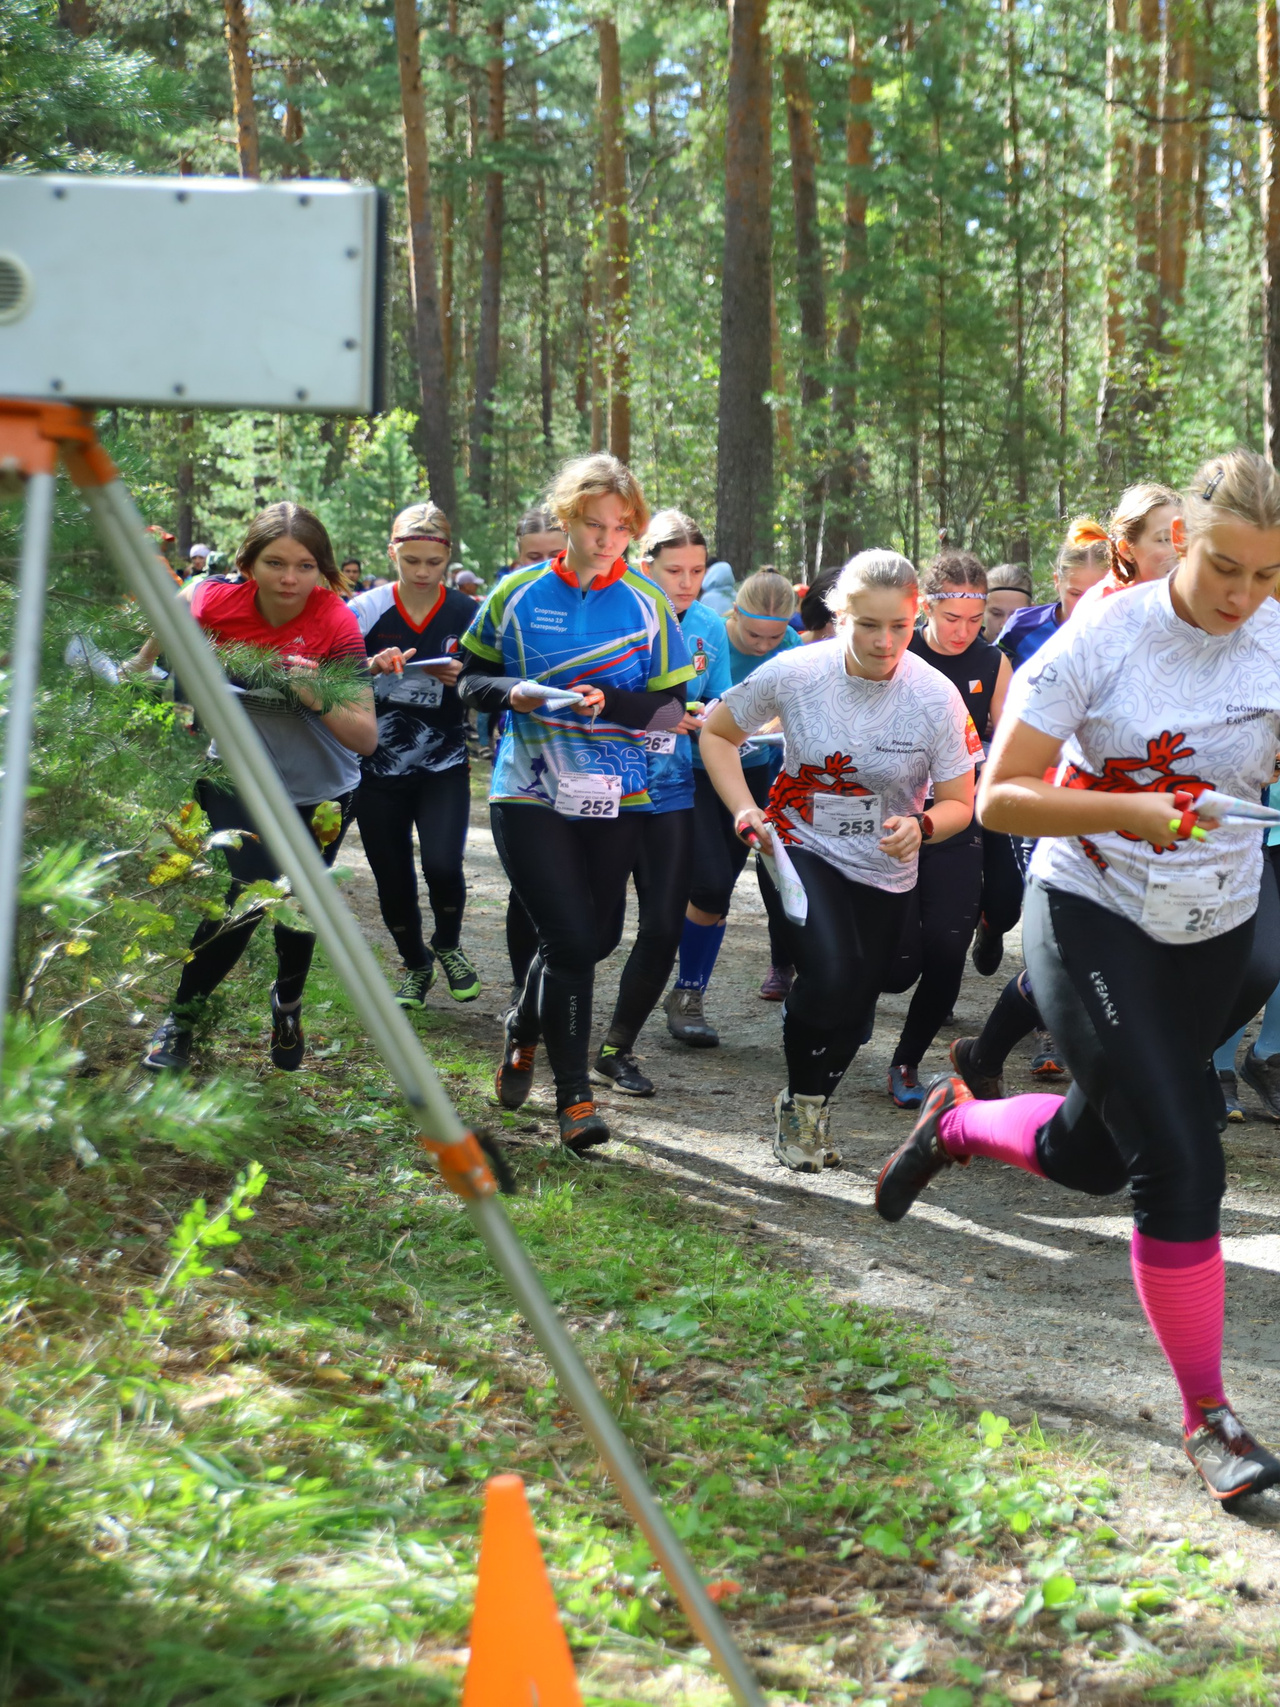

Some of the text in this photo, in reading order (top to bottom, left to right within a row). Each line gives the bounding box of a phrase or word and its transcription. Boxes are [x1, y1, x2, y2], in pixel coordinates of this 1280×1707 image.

[530, 622, 568, 633] Екатеринбург
[409, 691, 438, 704] 273
[580, 799, 615, 816] 252
[838, 819, 875, 836] 253
